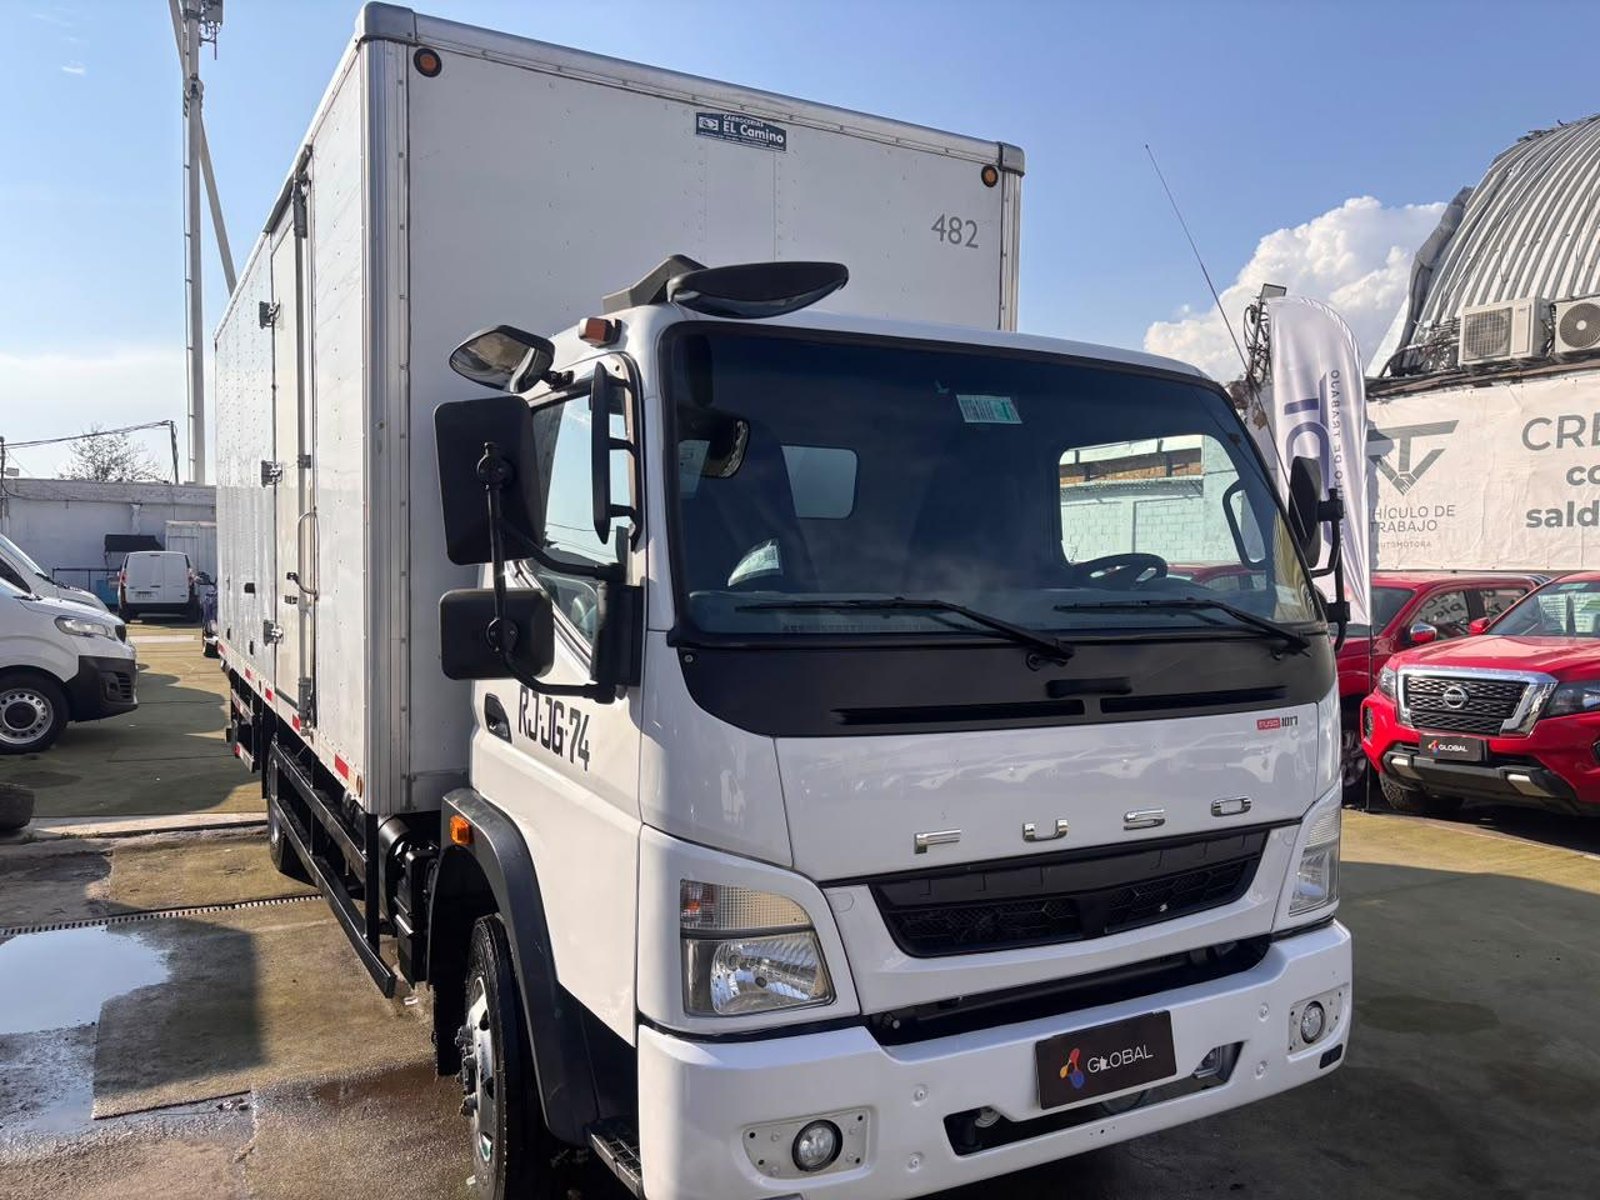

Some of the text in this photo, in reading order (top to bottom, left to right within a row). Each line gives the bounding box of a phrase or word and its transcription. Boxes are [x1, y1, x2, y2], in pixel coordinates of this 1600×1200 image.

[723, 121, 737, 134] EL
[740, 124, 784, 143] Camino
[930, 213, 979, 249] 482
[1372, 504, 1456, 519] HÍCULO DE
[1369, 519, 1438, 532] TRABAJO
[1438, 743, 1469, 752] GLOBAL
[914, 795, 1252, 854] FUSO
[1087, 1044, 1154, 1073] GLOBAL
